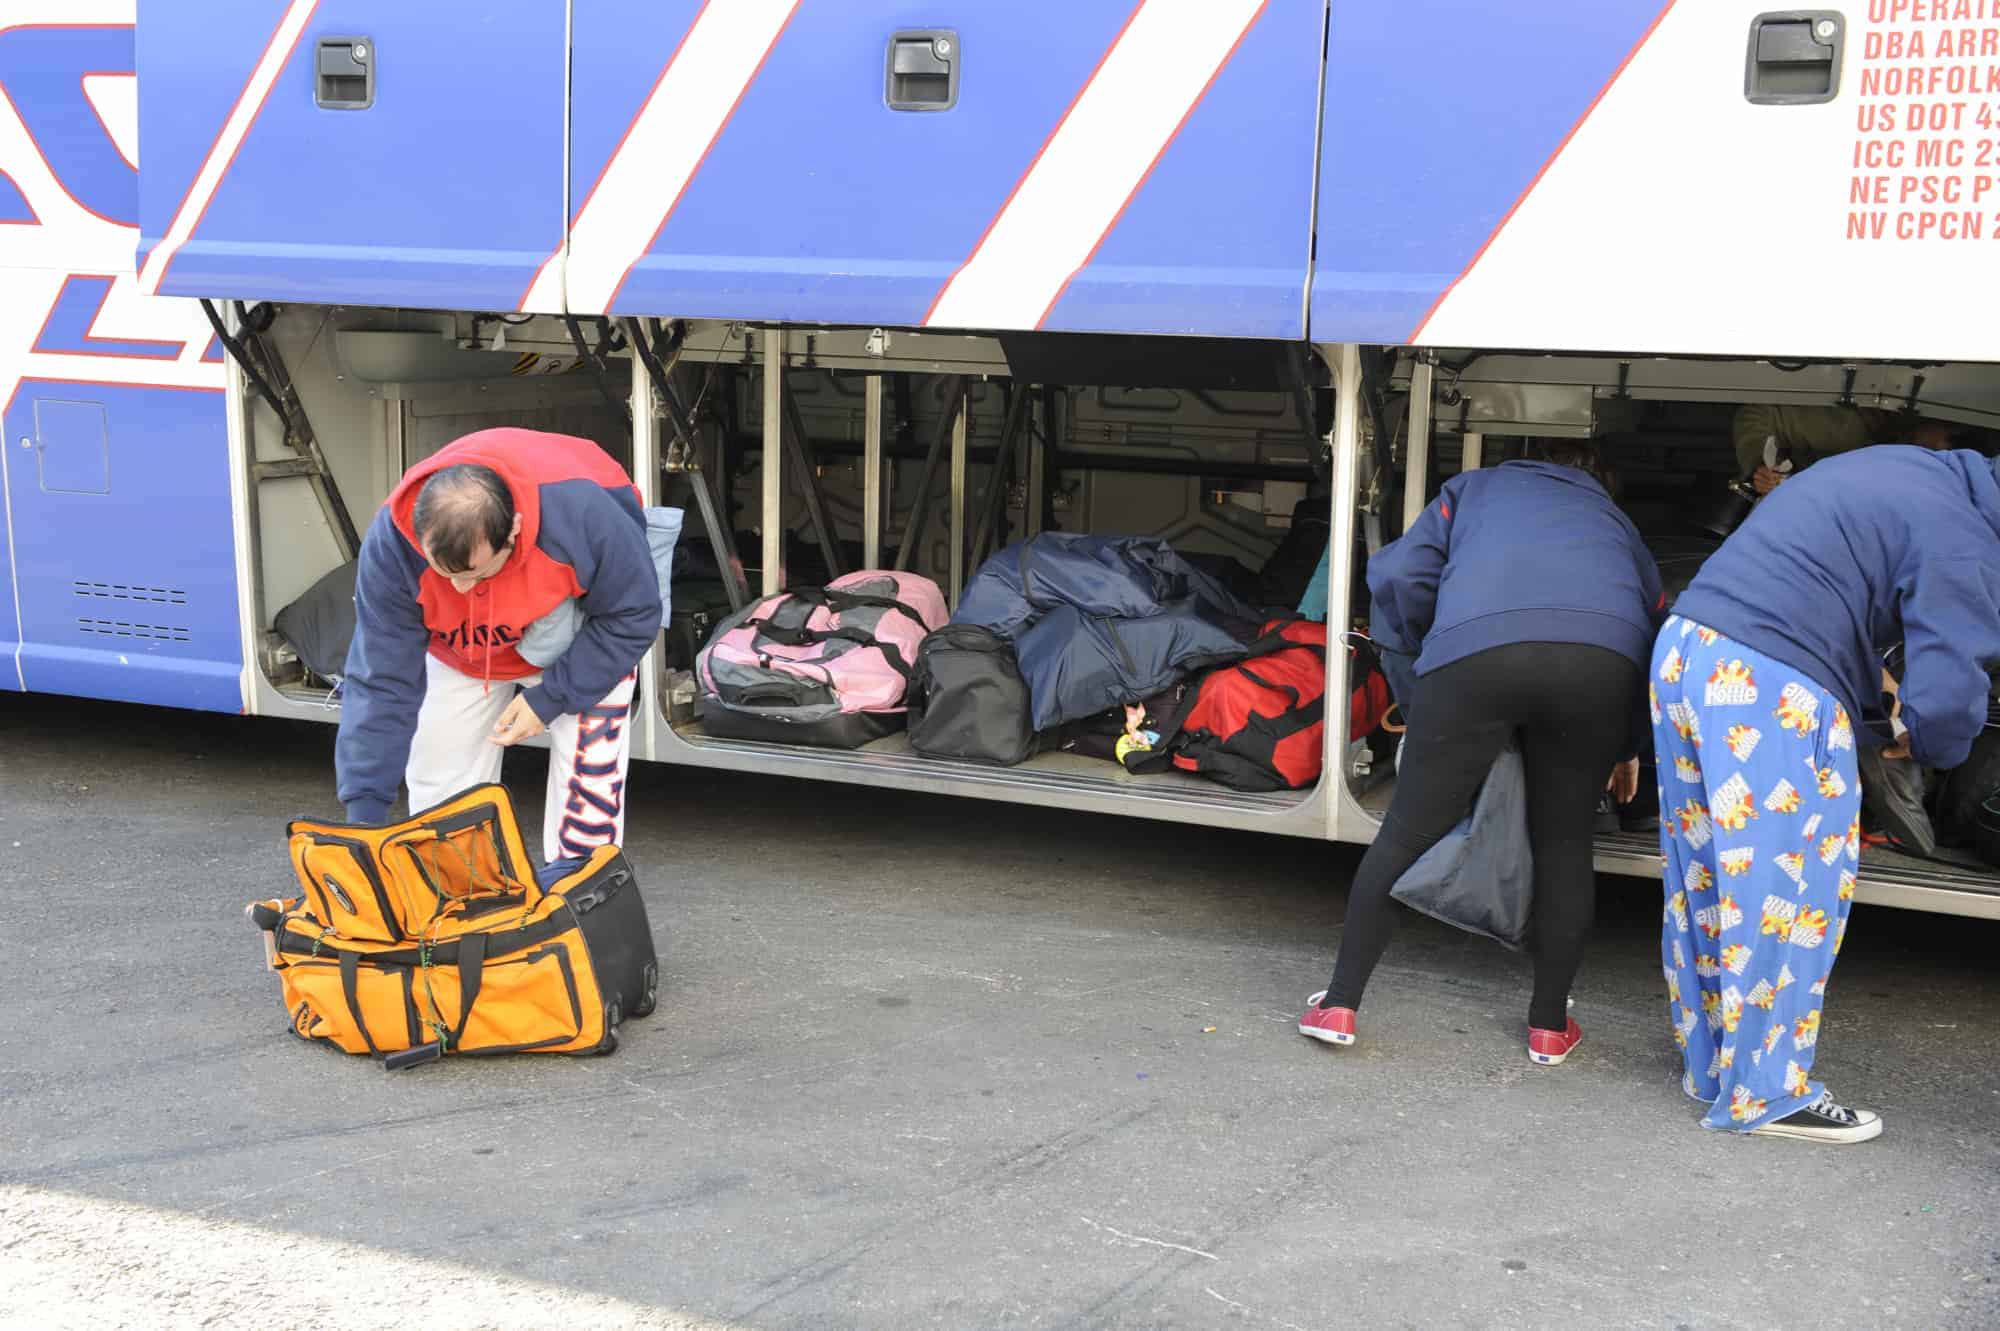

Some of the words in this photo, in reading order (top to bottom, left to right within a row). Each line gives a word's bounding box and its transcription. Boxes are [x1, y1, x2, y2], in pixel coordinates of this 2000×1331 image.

[1863, 31, 1924, 60] DBA
[1935, 28, 2000, 59] ARR
[1860, 65, 2000, 97] NORFOLK
[1857, 103, 1896, 133] US
[1906, 102, 1967, 131] DOT
[1853, 139, 1905, 169] ICC
[1915, 139, 1965, 168] MC
[1849, 176, 1890, 204] NE
[1899, 175, 1962, 204] PSC
[1972, 175, 2000, 204] P
[1846, 211, 1888, 240] NV
[1896, 211, 1983, 240] CPCN
